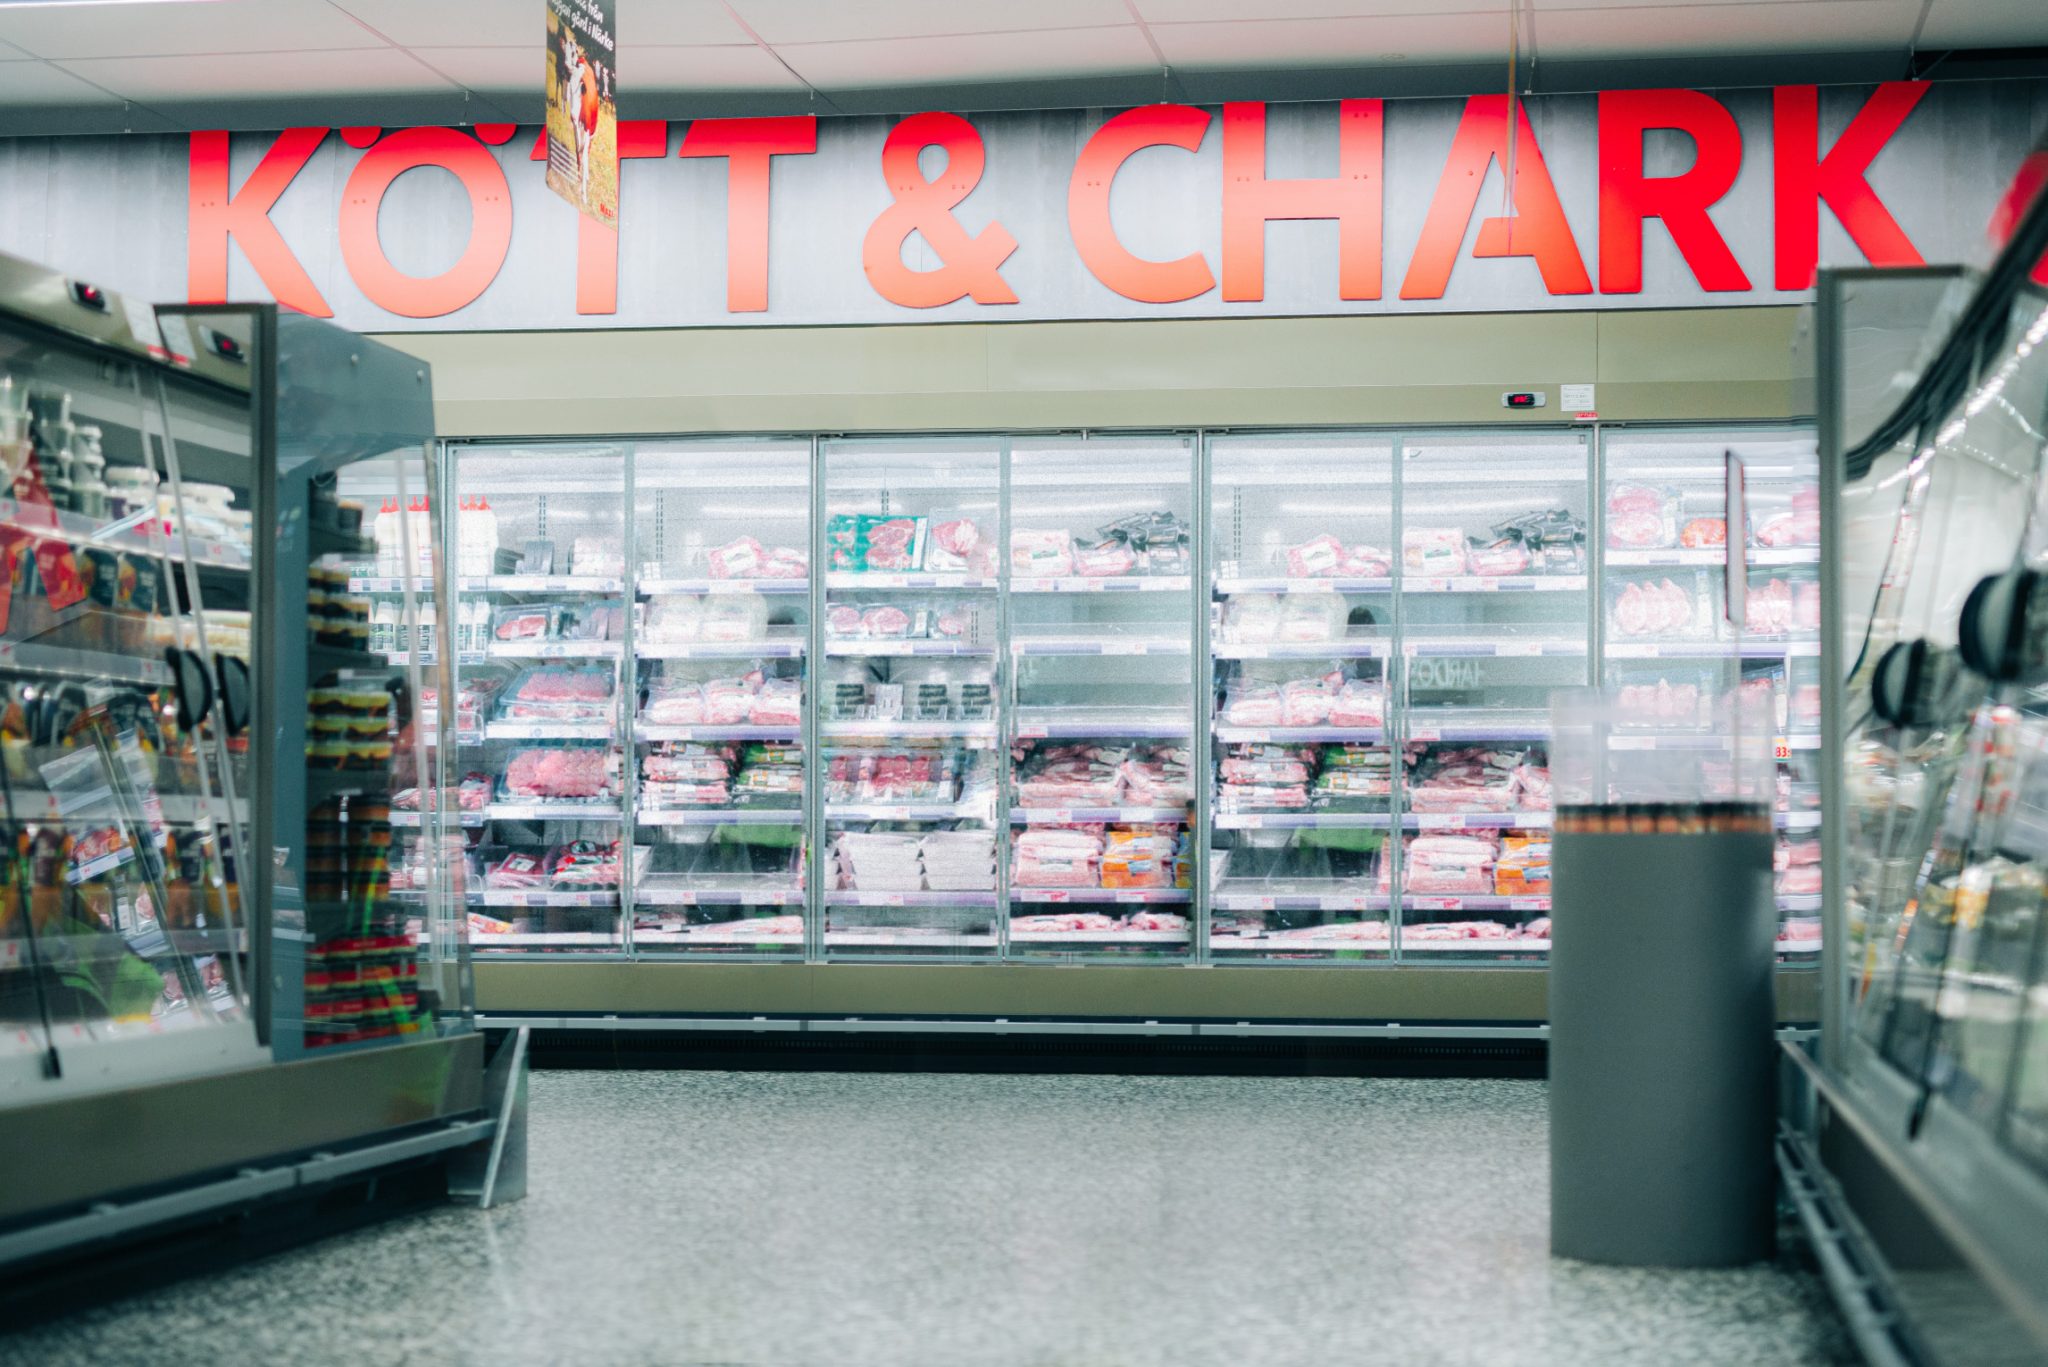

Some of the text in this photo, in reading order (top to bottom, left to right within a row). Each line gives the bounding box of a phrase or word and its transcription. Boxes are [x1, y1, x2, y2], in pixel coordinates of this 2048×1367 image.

[571, 11, 588, 32] gård
[588, 21, 592, 35] i
[592, 24, 614, 51] Närke
[187, 116, 817, 318] KÖTT
[862, 111, 1020, 308] &
[1068, 81, 1933, 304] CHARK
